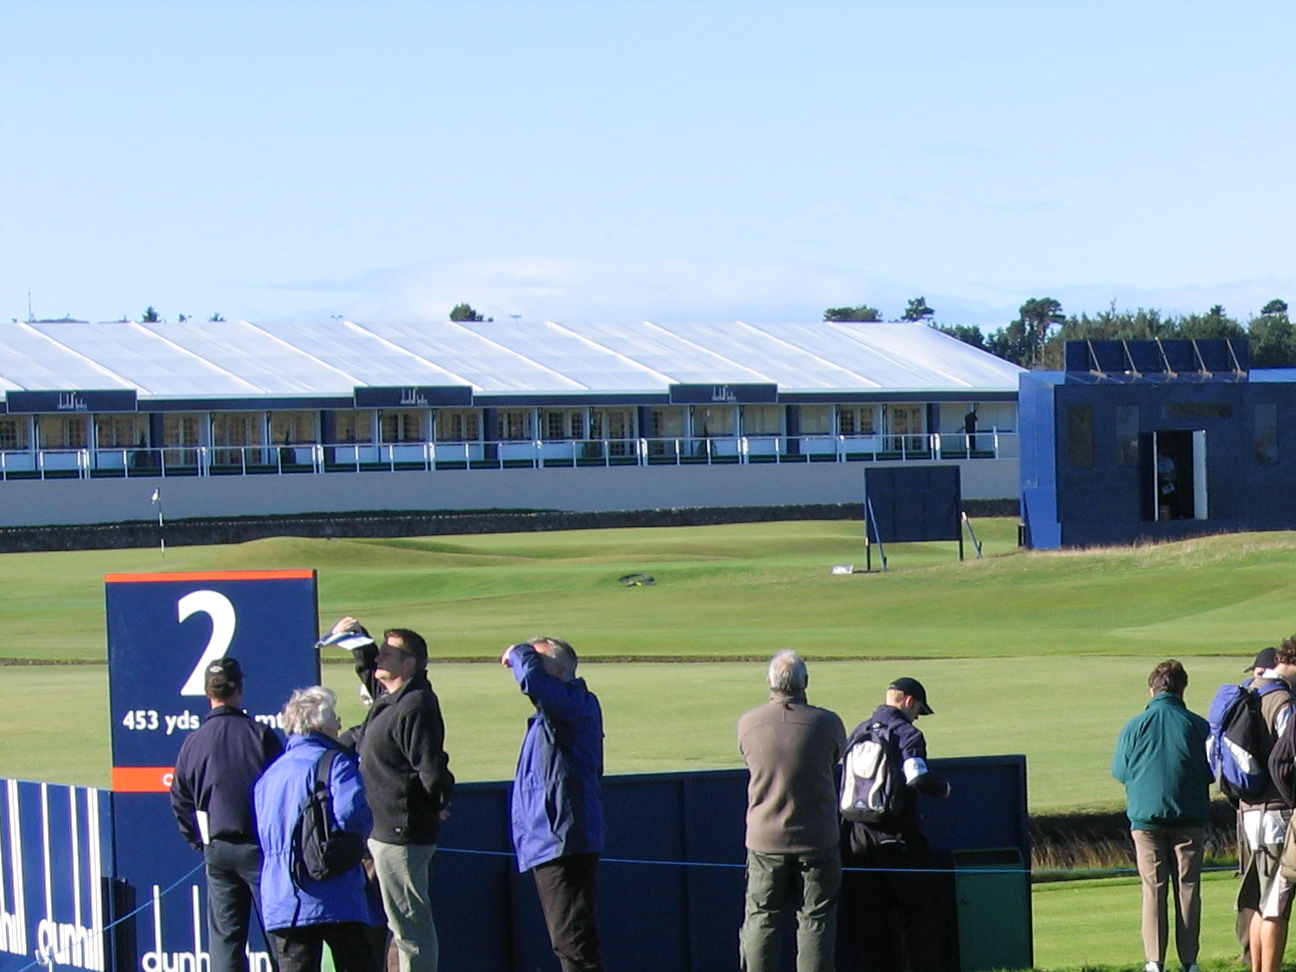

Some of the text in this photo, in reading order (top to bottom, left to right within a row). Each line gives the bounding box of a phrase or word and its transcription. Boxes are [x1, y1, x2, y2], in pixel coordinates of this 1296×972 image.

[178, 590, 236, 696] 2
[122, 710, 159, 730] 453
[165, 710, 200, 735] yds
[37, 782, 105, 972] dunhill
